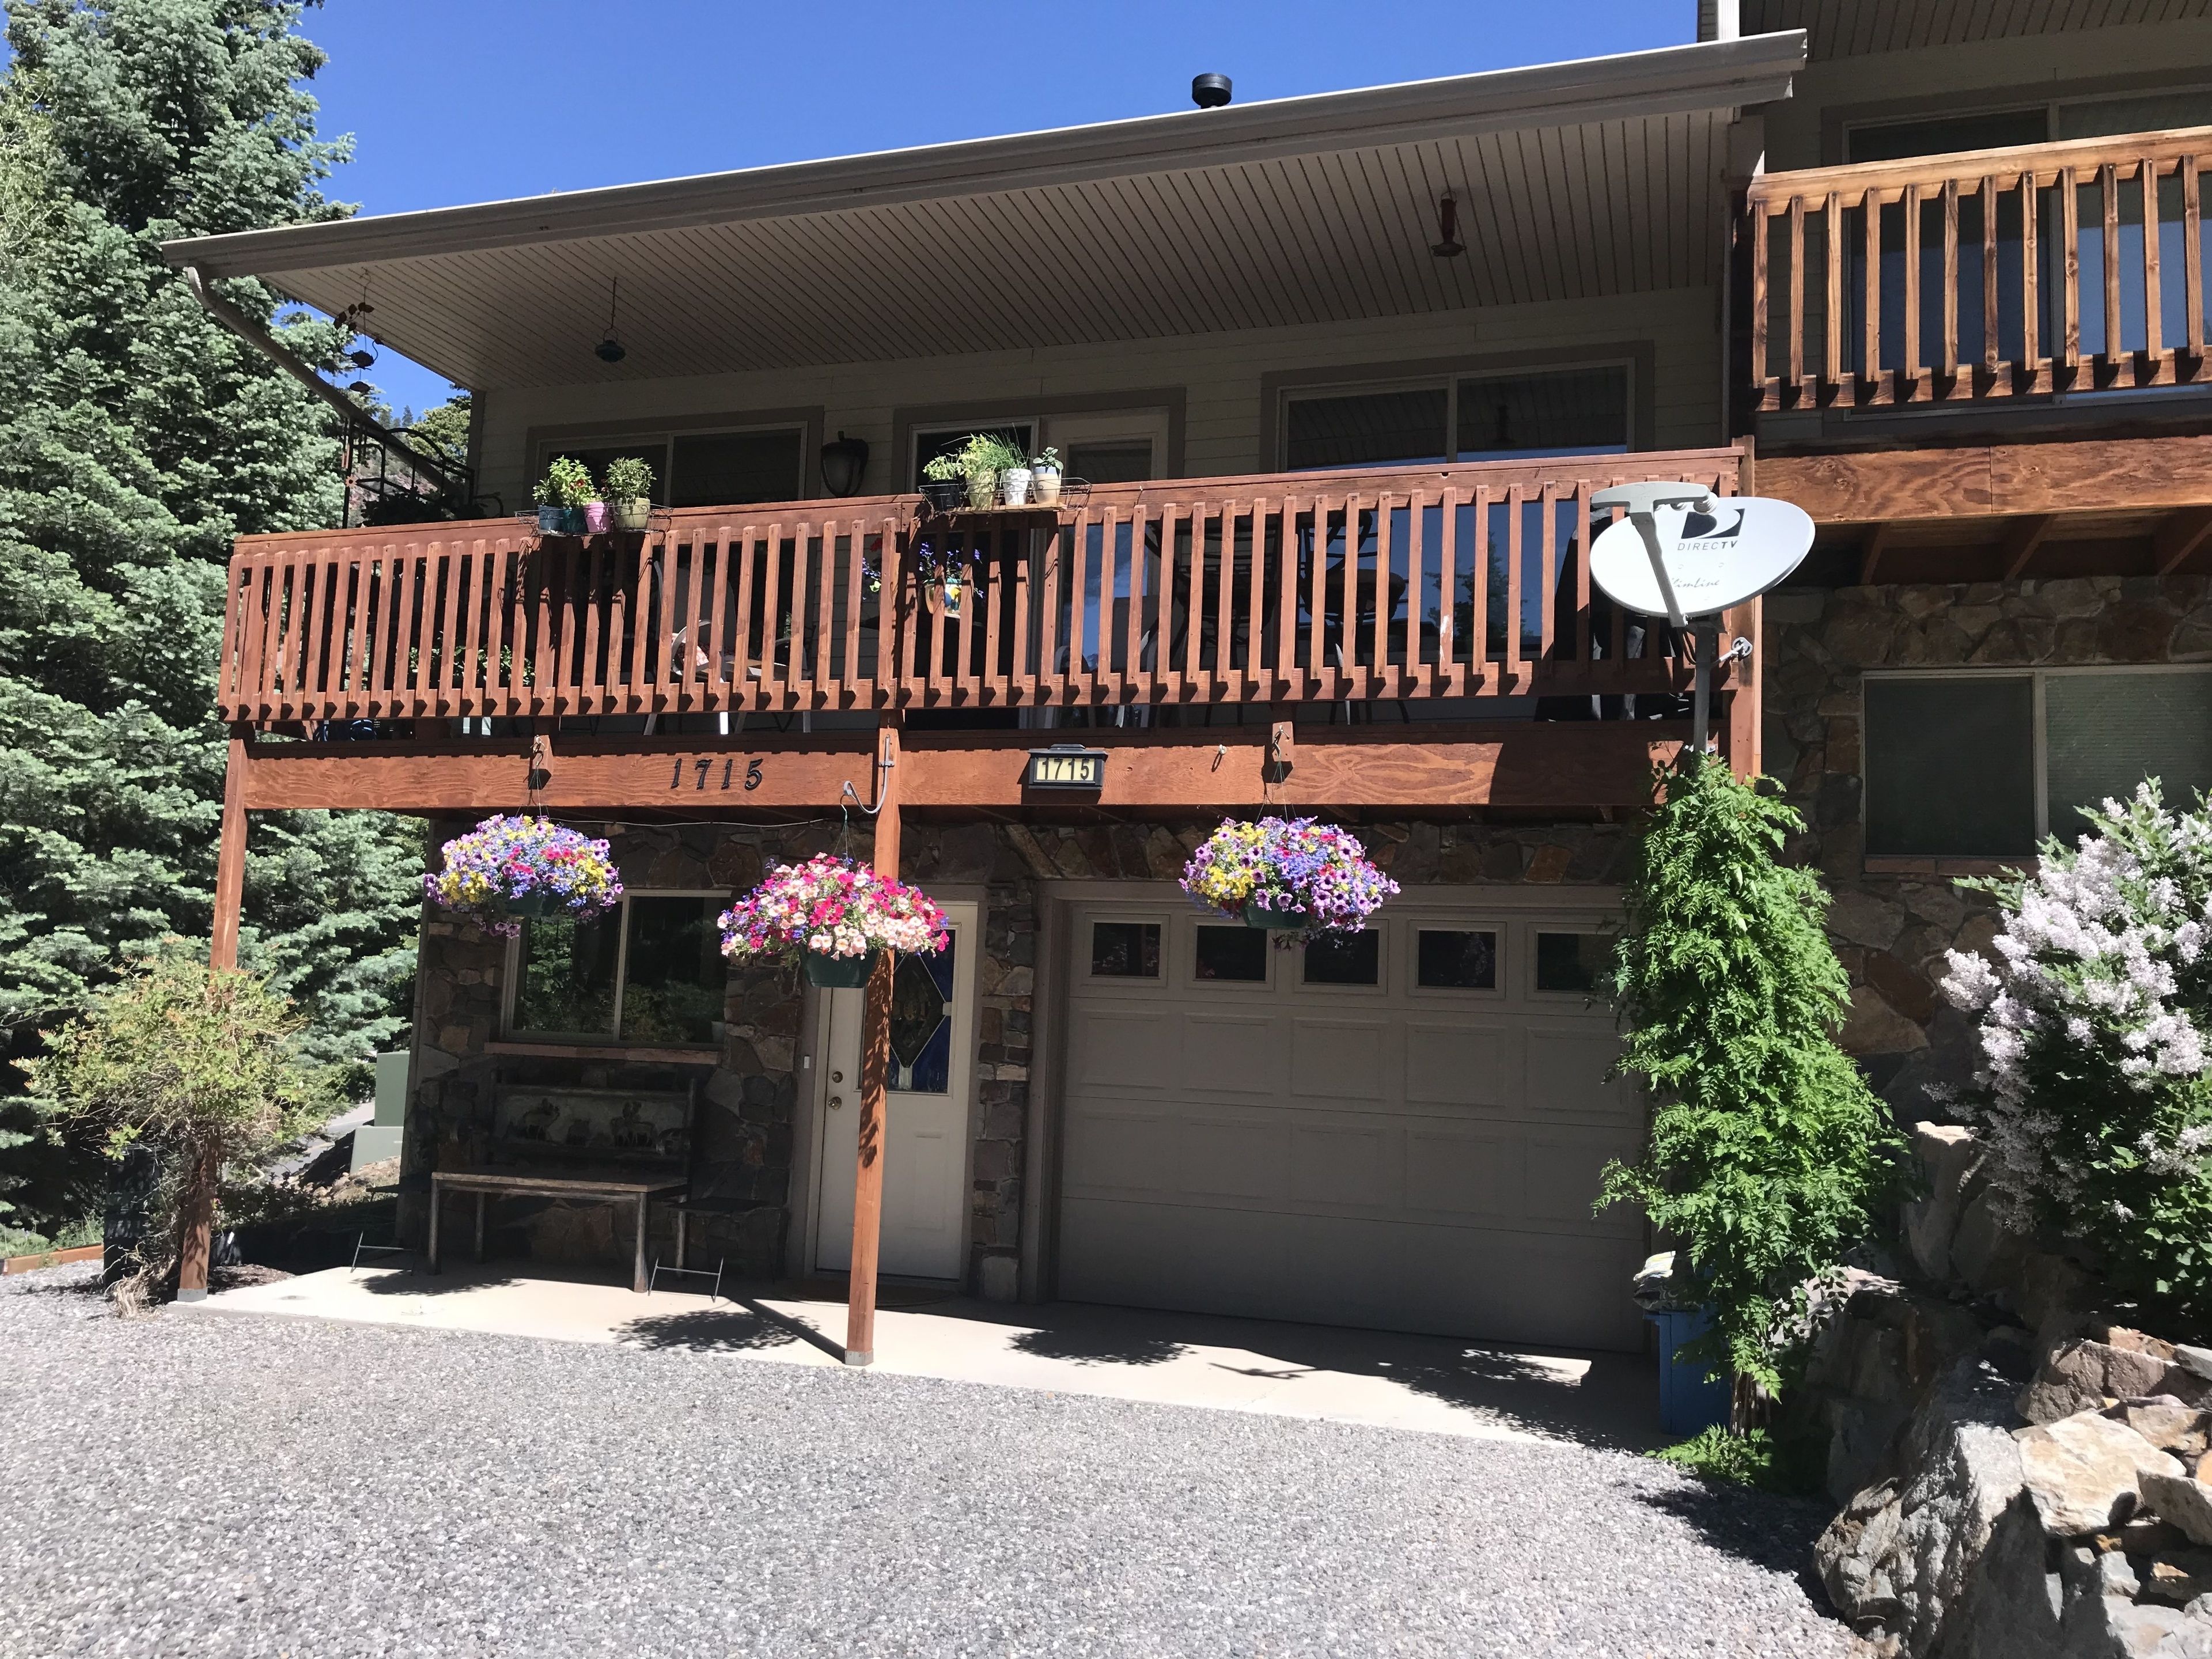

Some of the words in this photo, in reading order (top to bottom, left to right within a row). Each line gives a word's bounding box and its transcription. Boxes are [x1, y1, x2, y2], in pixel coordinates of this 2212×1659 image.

[1677, 540, 1738, 551] DIRECTV
[671, 758, 764, 790] 1715
[1042, 757, 1090, 780] 1715
